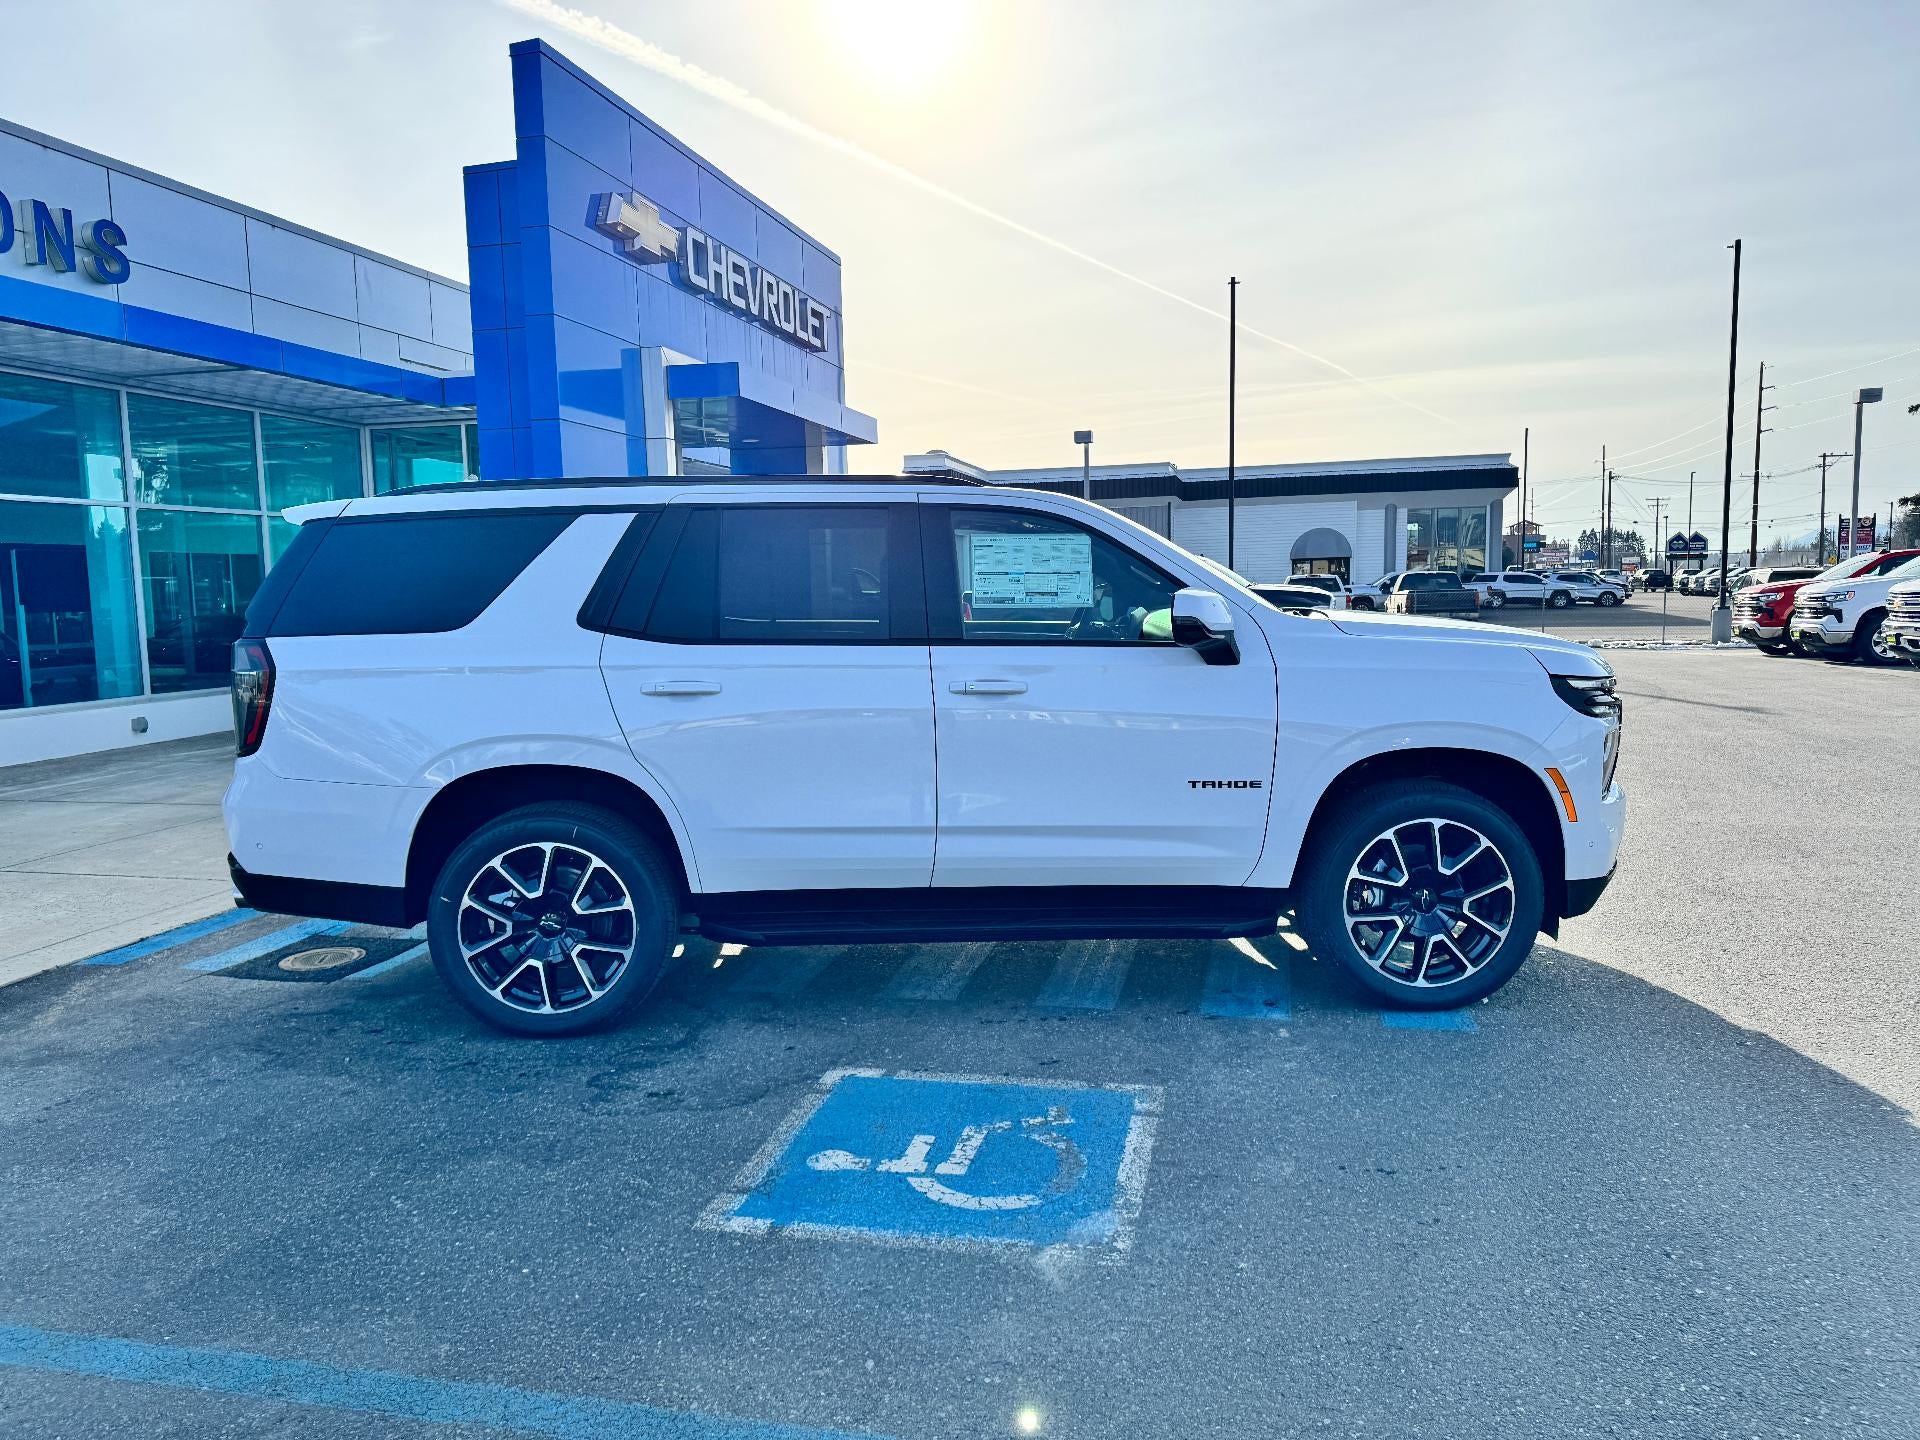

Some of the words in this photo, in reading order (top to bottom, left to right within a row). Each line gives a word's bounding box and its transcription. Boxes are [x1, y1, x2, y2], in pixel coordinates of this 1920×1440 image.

[0, 190, 131, 284] NS
[684, 226, 831, 352] CHEVROLET
[1187, 780, 1263, 789] TAHOE
